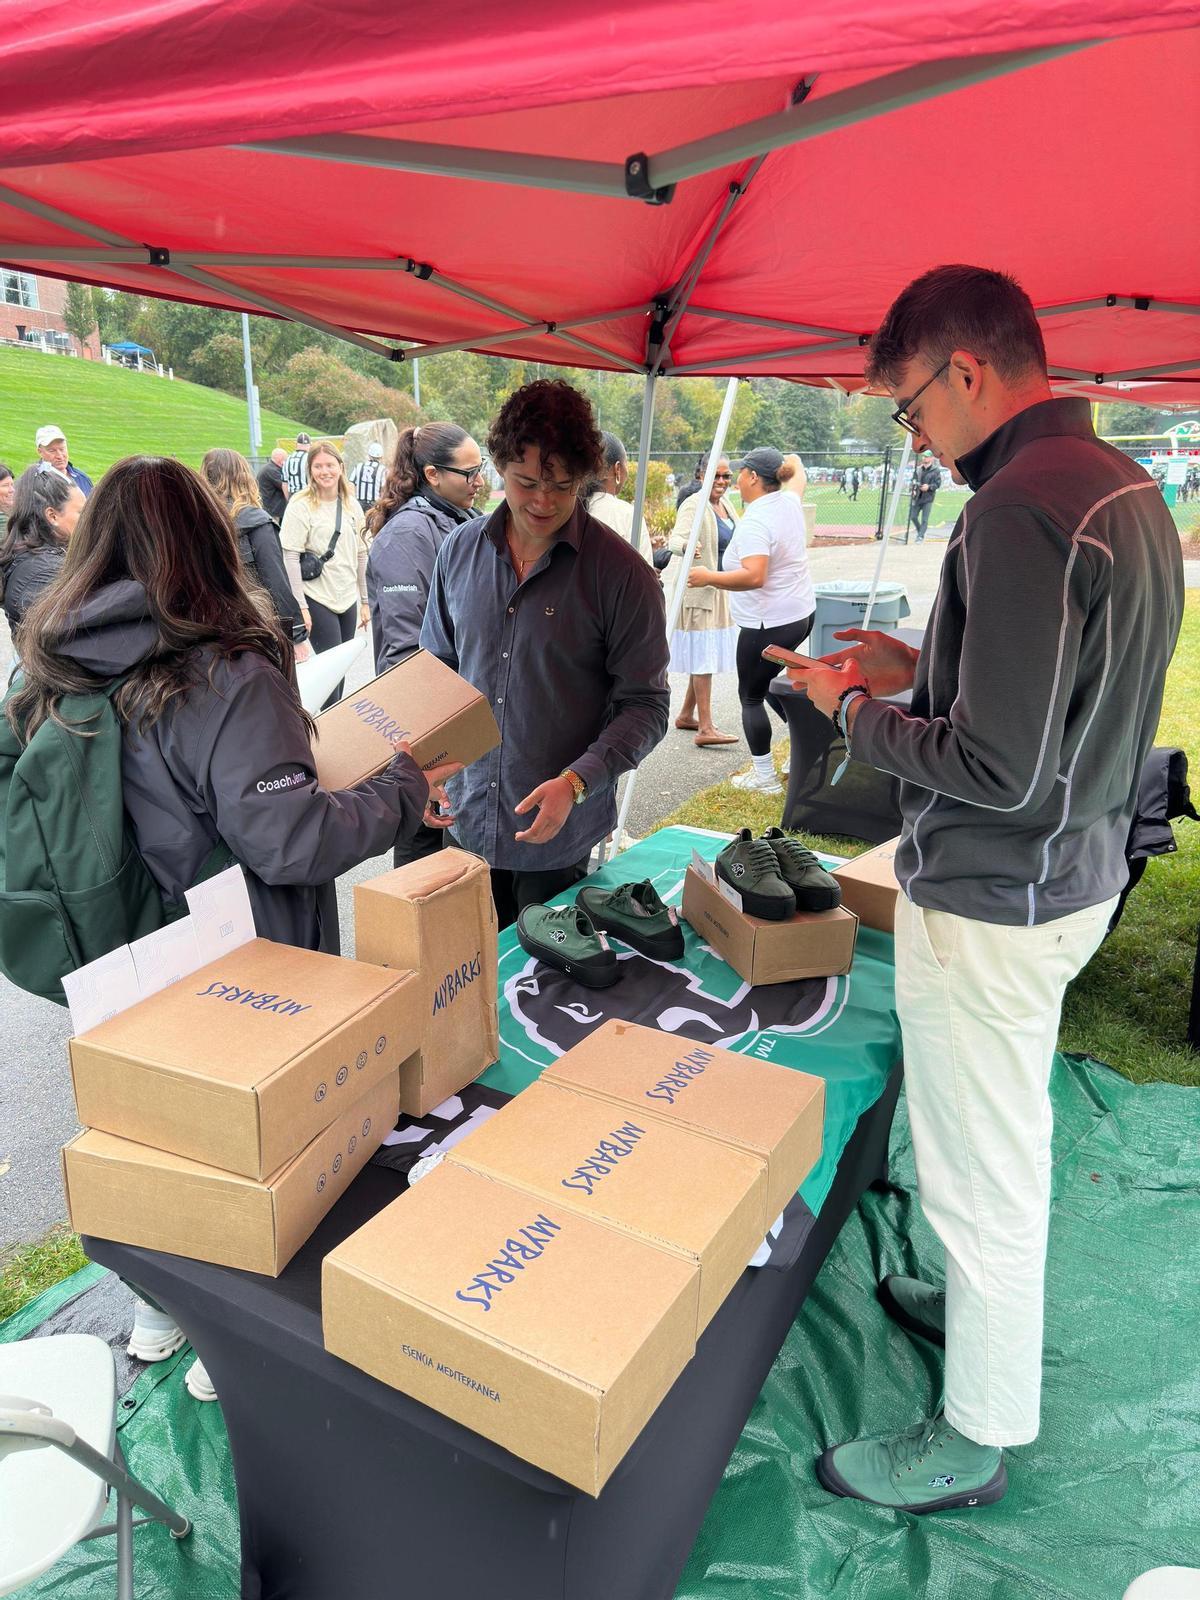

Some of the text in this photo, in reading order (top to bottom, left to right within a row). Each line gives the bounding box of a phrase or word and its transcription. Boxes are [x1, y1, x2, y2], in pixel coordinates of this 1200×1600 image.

[361, 464, 374, 482] R
[196, 981, 312, 1015] MYBARKS
[432, 951, 480, 1016] MYBARKS
[754, 1037, 776, 1058] TM
[645, 1047, 715, 1104] MYBARKS
[561, 1120, 646, 1195] MYBARKS
[455, 1213, 561, 1312] MYBARKS
[402, 1344, 433, 1367] ESENCIA
